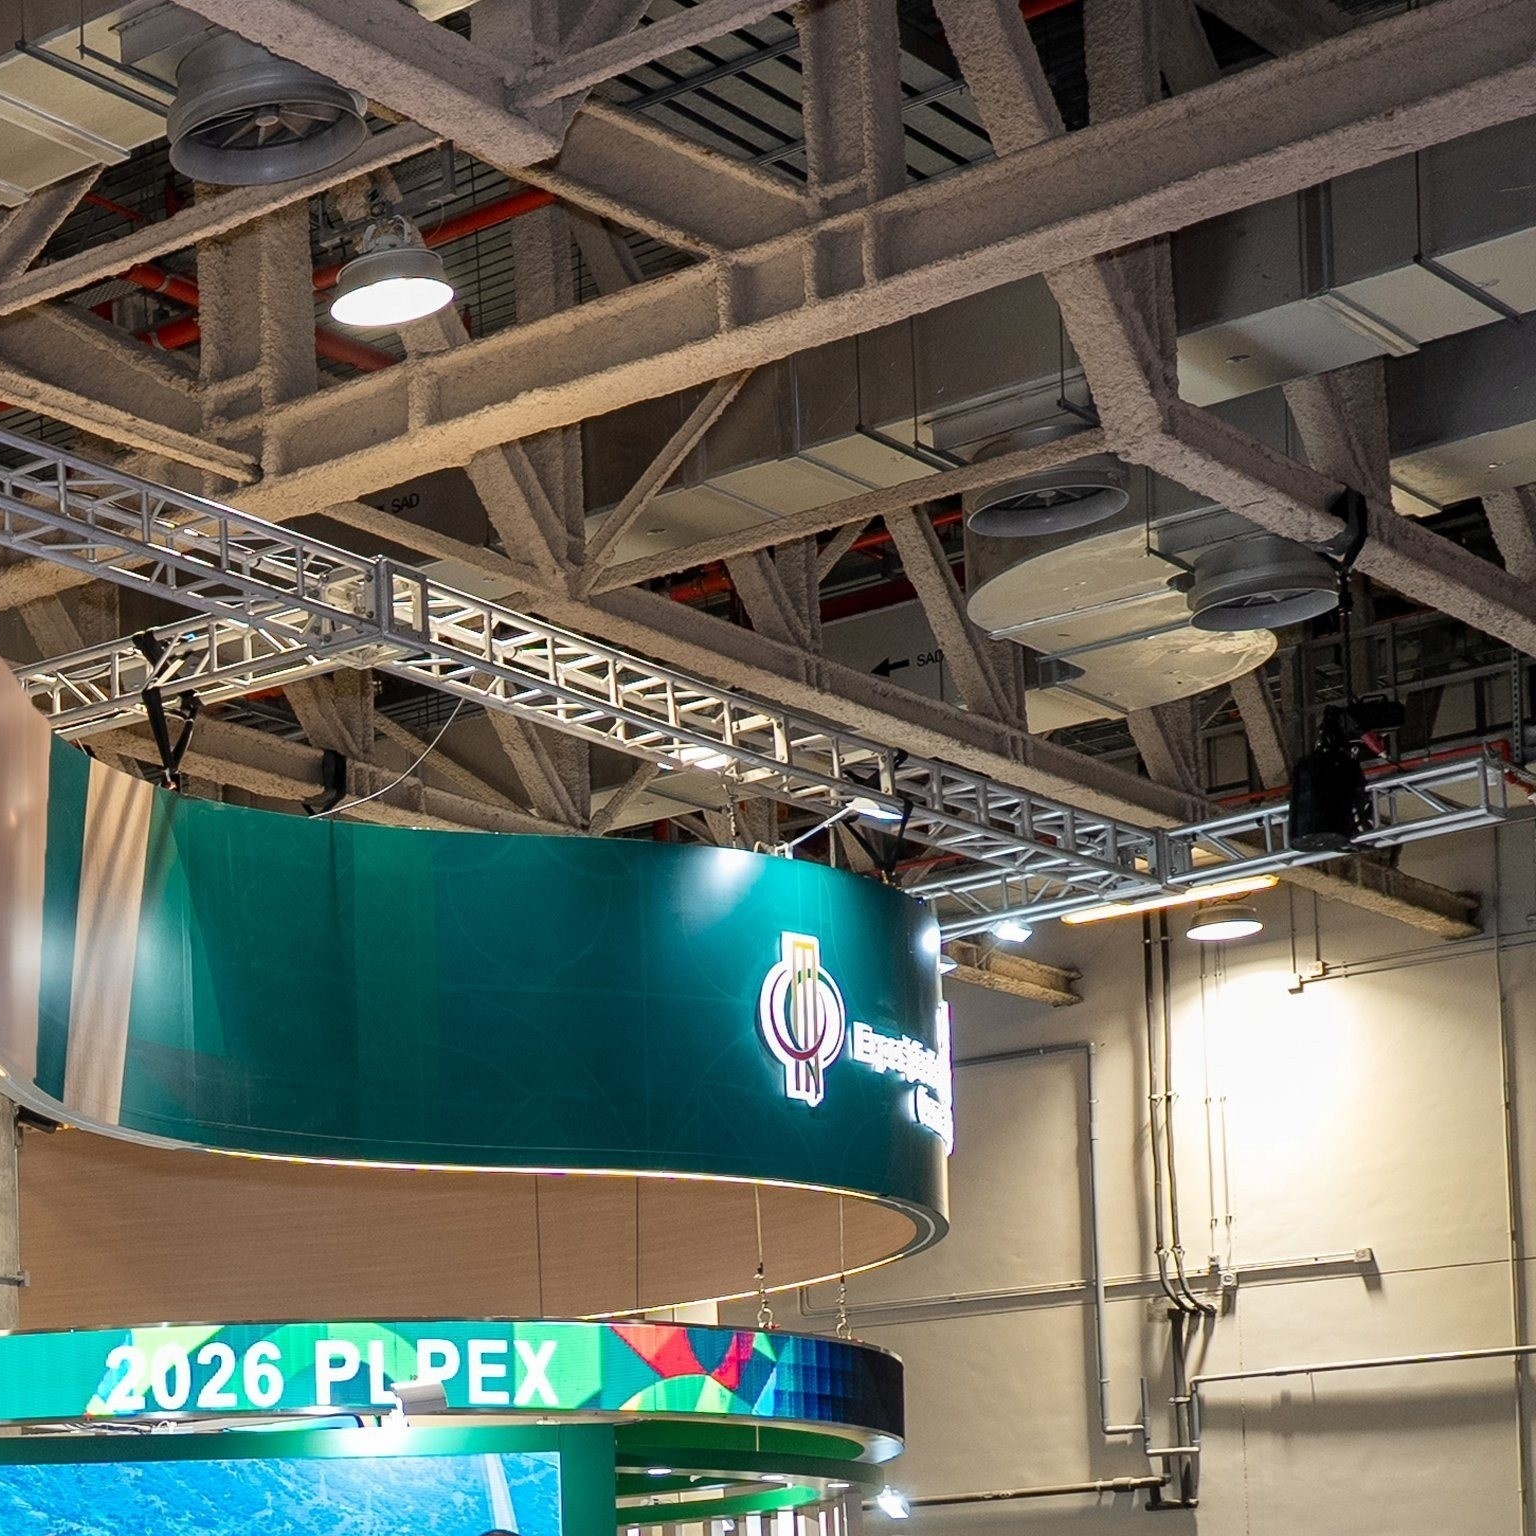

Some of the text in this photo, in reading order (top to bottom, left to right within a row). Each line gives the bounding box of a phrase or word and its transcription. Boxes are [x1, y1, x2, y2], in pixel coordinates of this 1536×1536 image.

[391, 493, 420, 513] SAD
[916, 648, 944, 667] SAD
[105, 1338, 560, 1410] 2026 PLPEX
